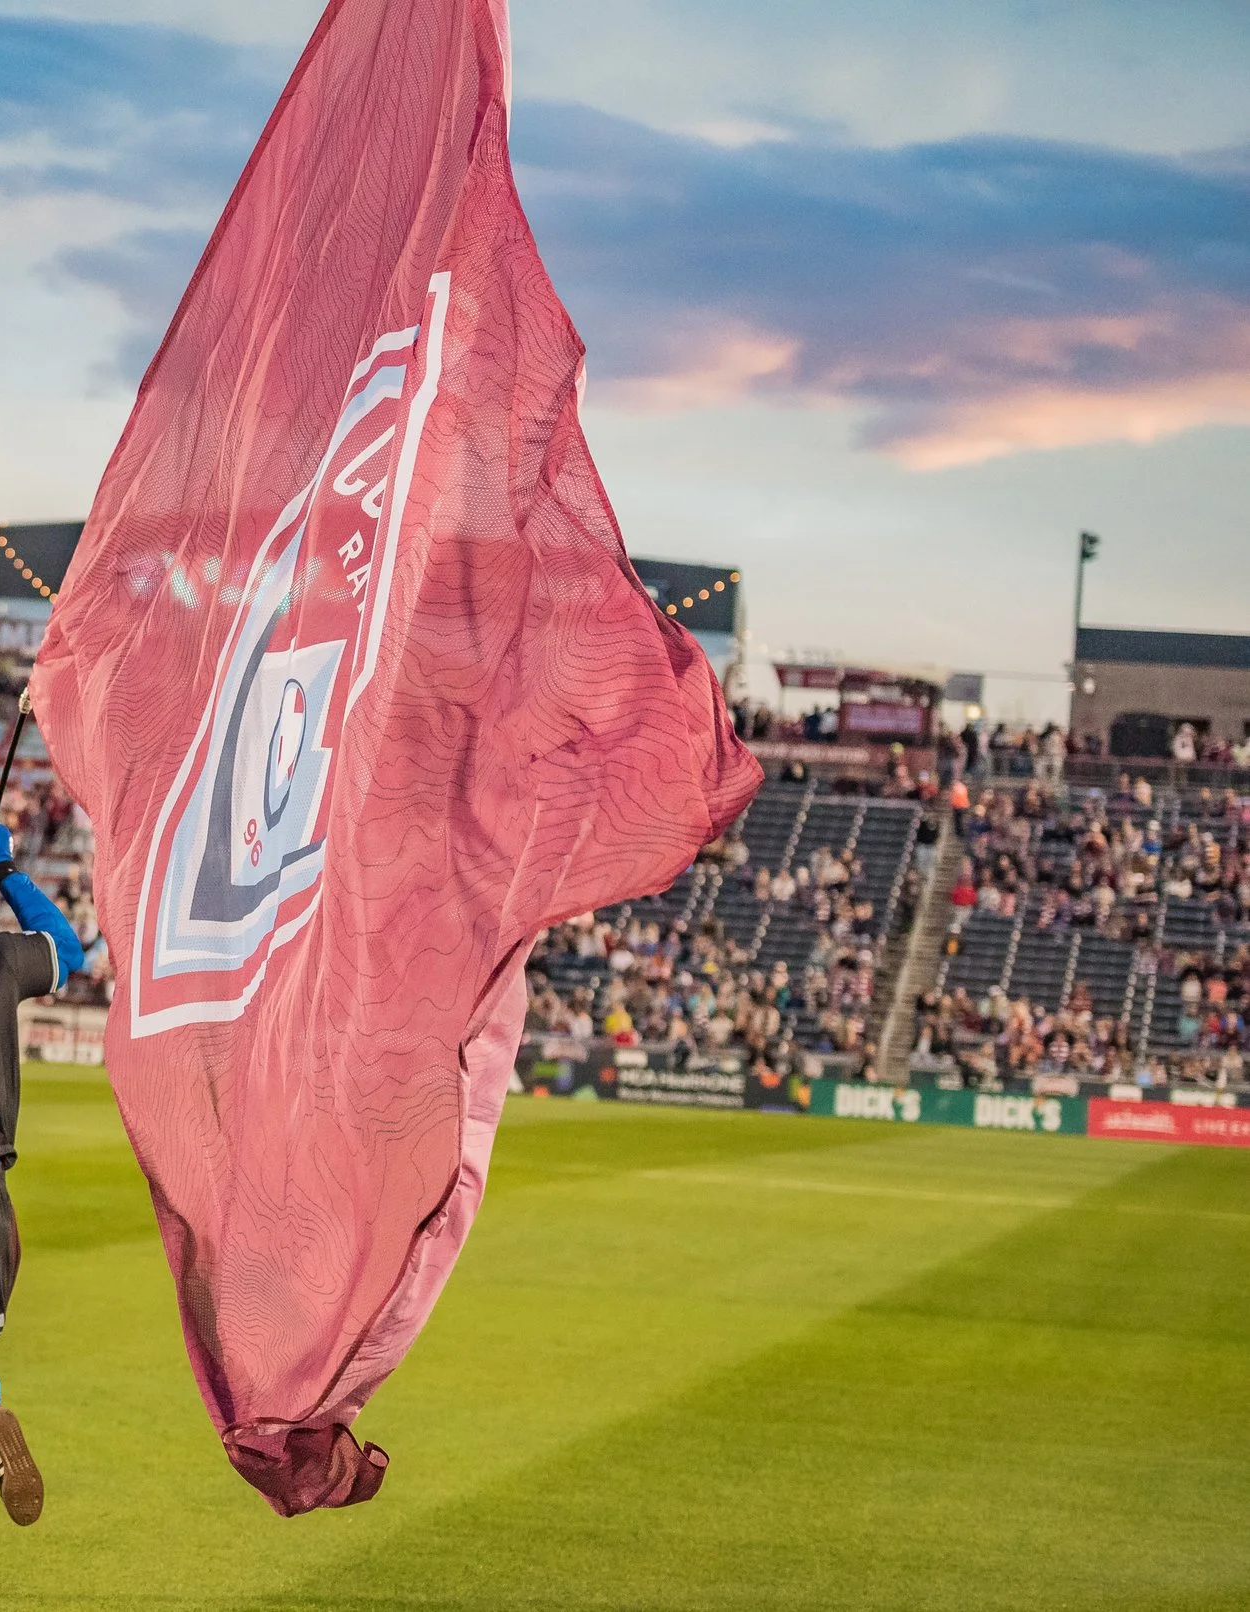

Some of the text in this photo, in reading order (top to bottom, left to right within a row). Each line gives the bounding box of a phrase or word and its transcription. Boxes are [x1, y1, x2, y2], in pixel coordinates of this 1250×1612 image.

[244, 818, 262, 867] 96
[835, 1084, 921, 1121] DICK'S
[974, 1094, 1061, 1131] DICK'S
